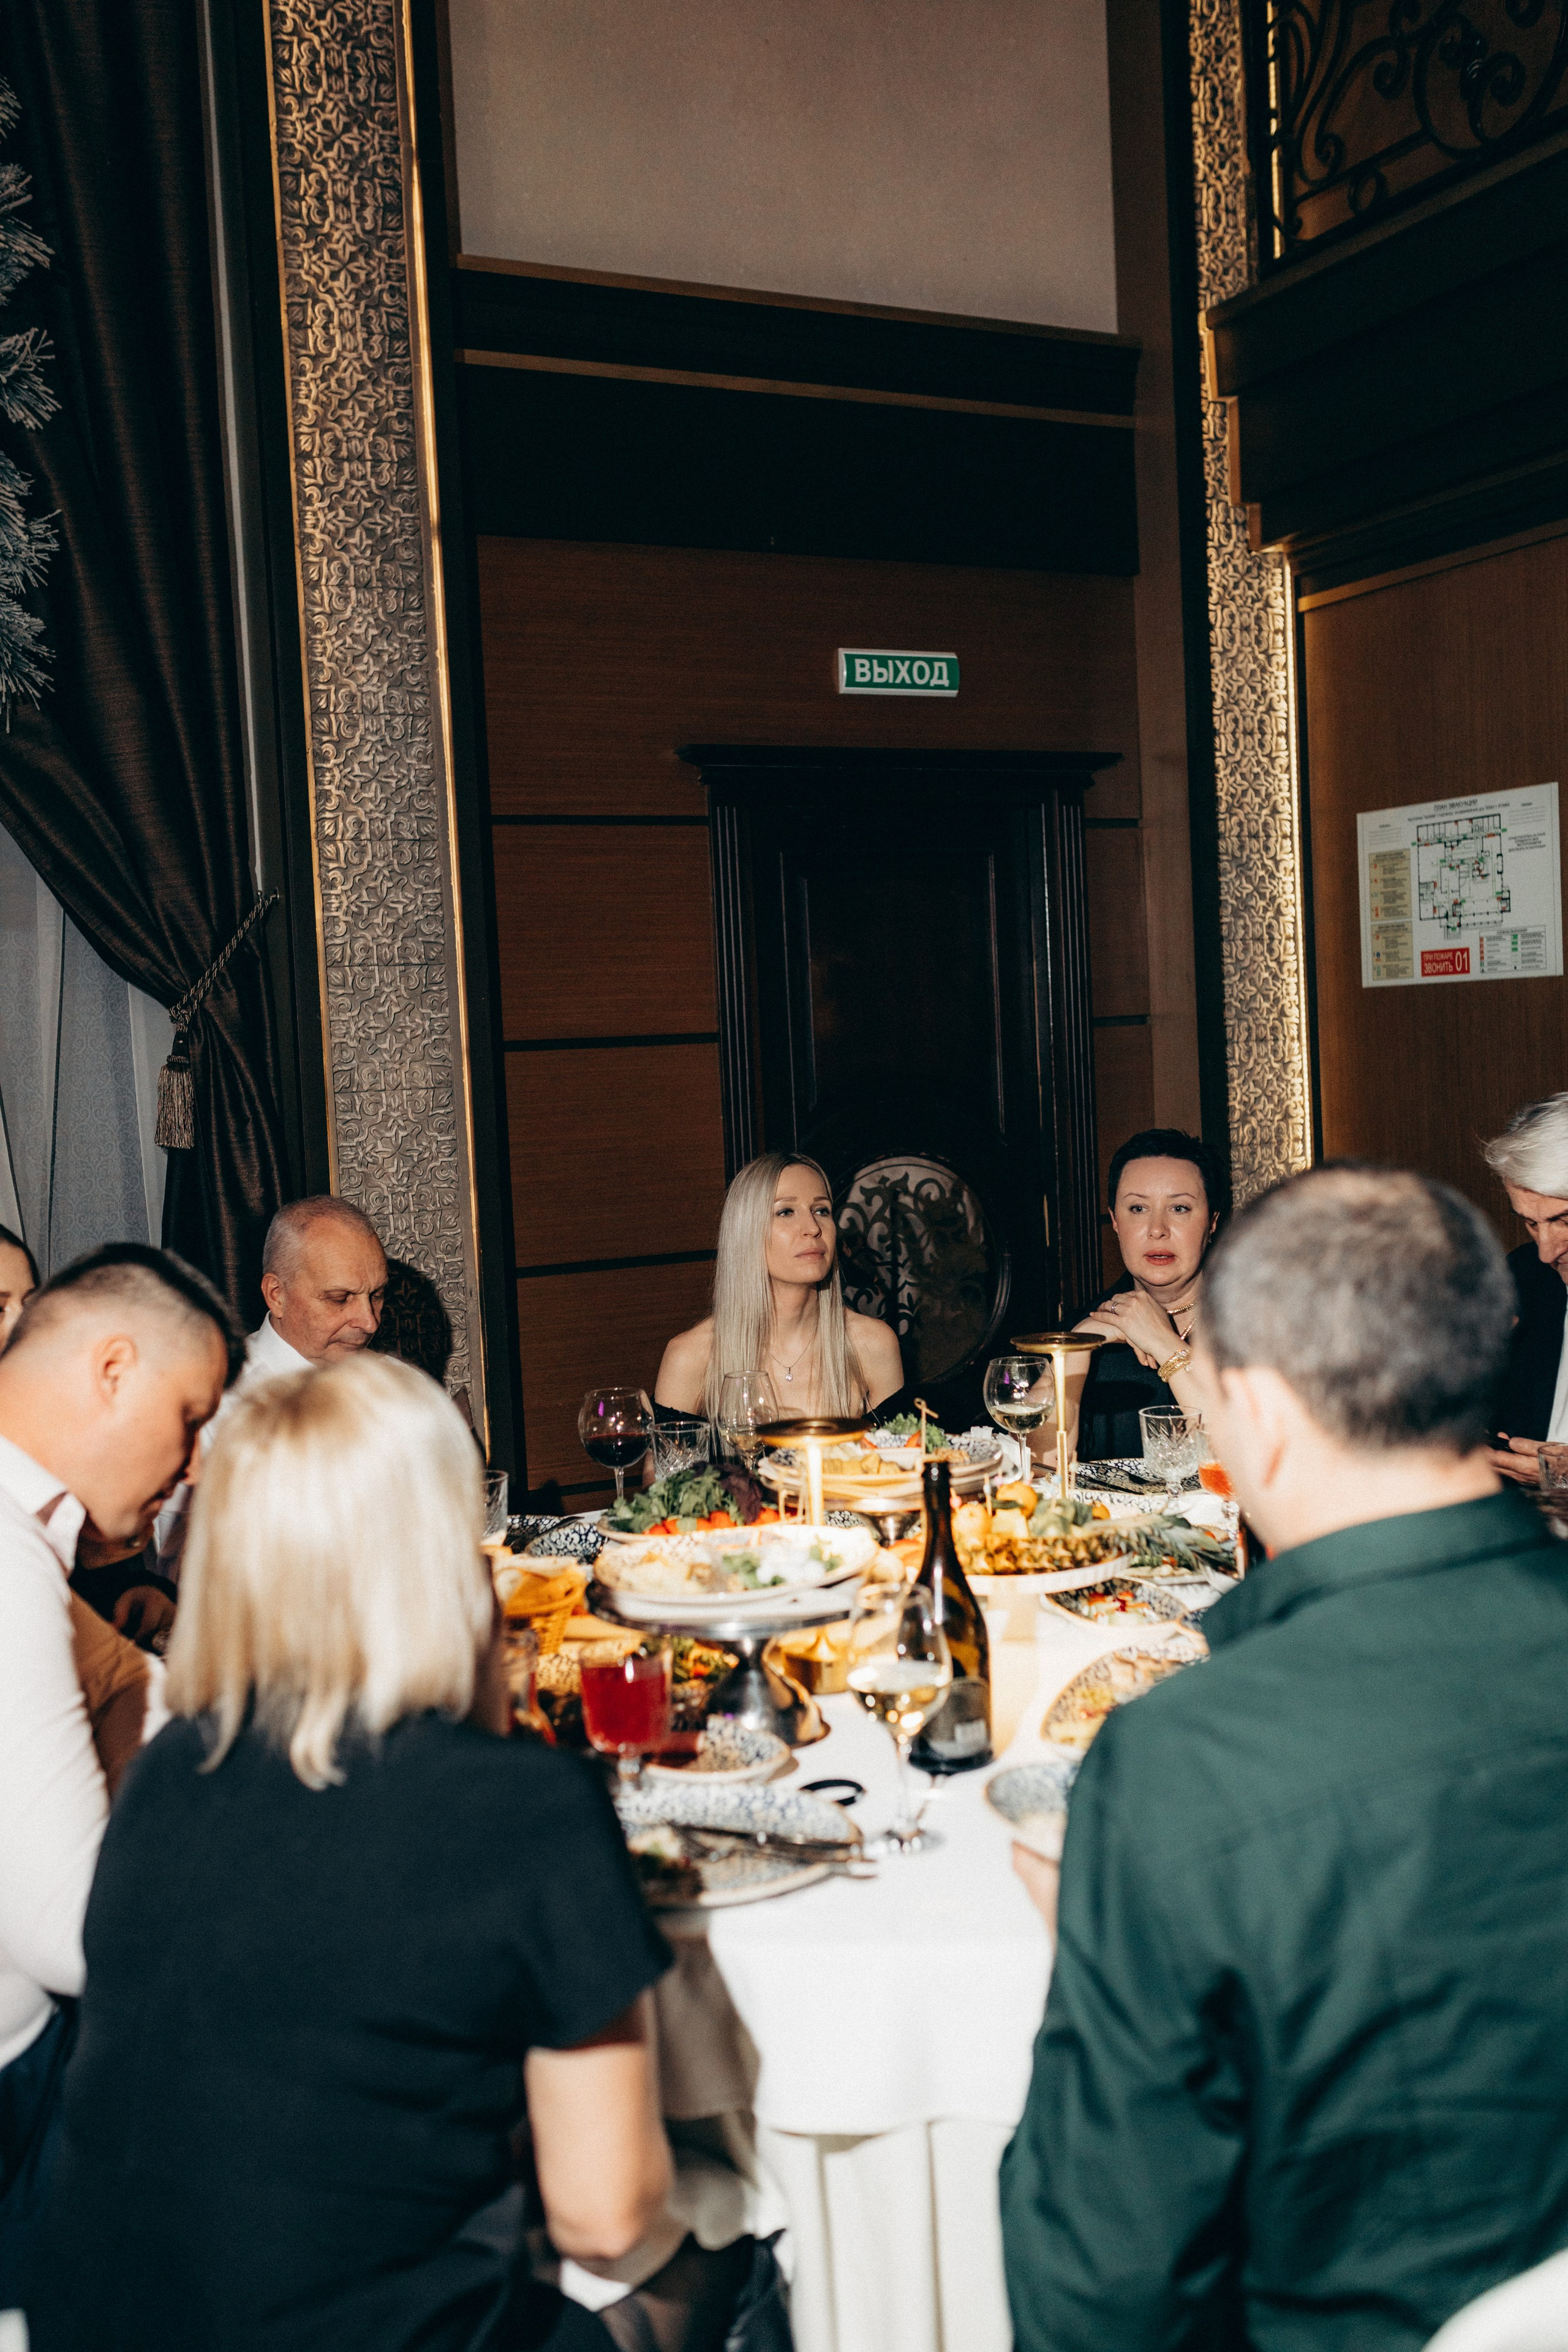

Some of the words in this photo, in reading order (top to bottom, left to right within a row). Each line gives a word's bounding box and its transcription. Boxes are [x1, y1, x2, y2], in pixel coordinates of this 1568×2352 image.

[854, 658, 949, 687] ВЫХОД
[1424, 960, 1453, 974] ЗВОНИТЬ
[1455, 951, 1468, 971] 01
